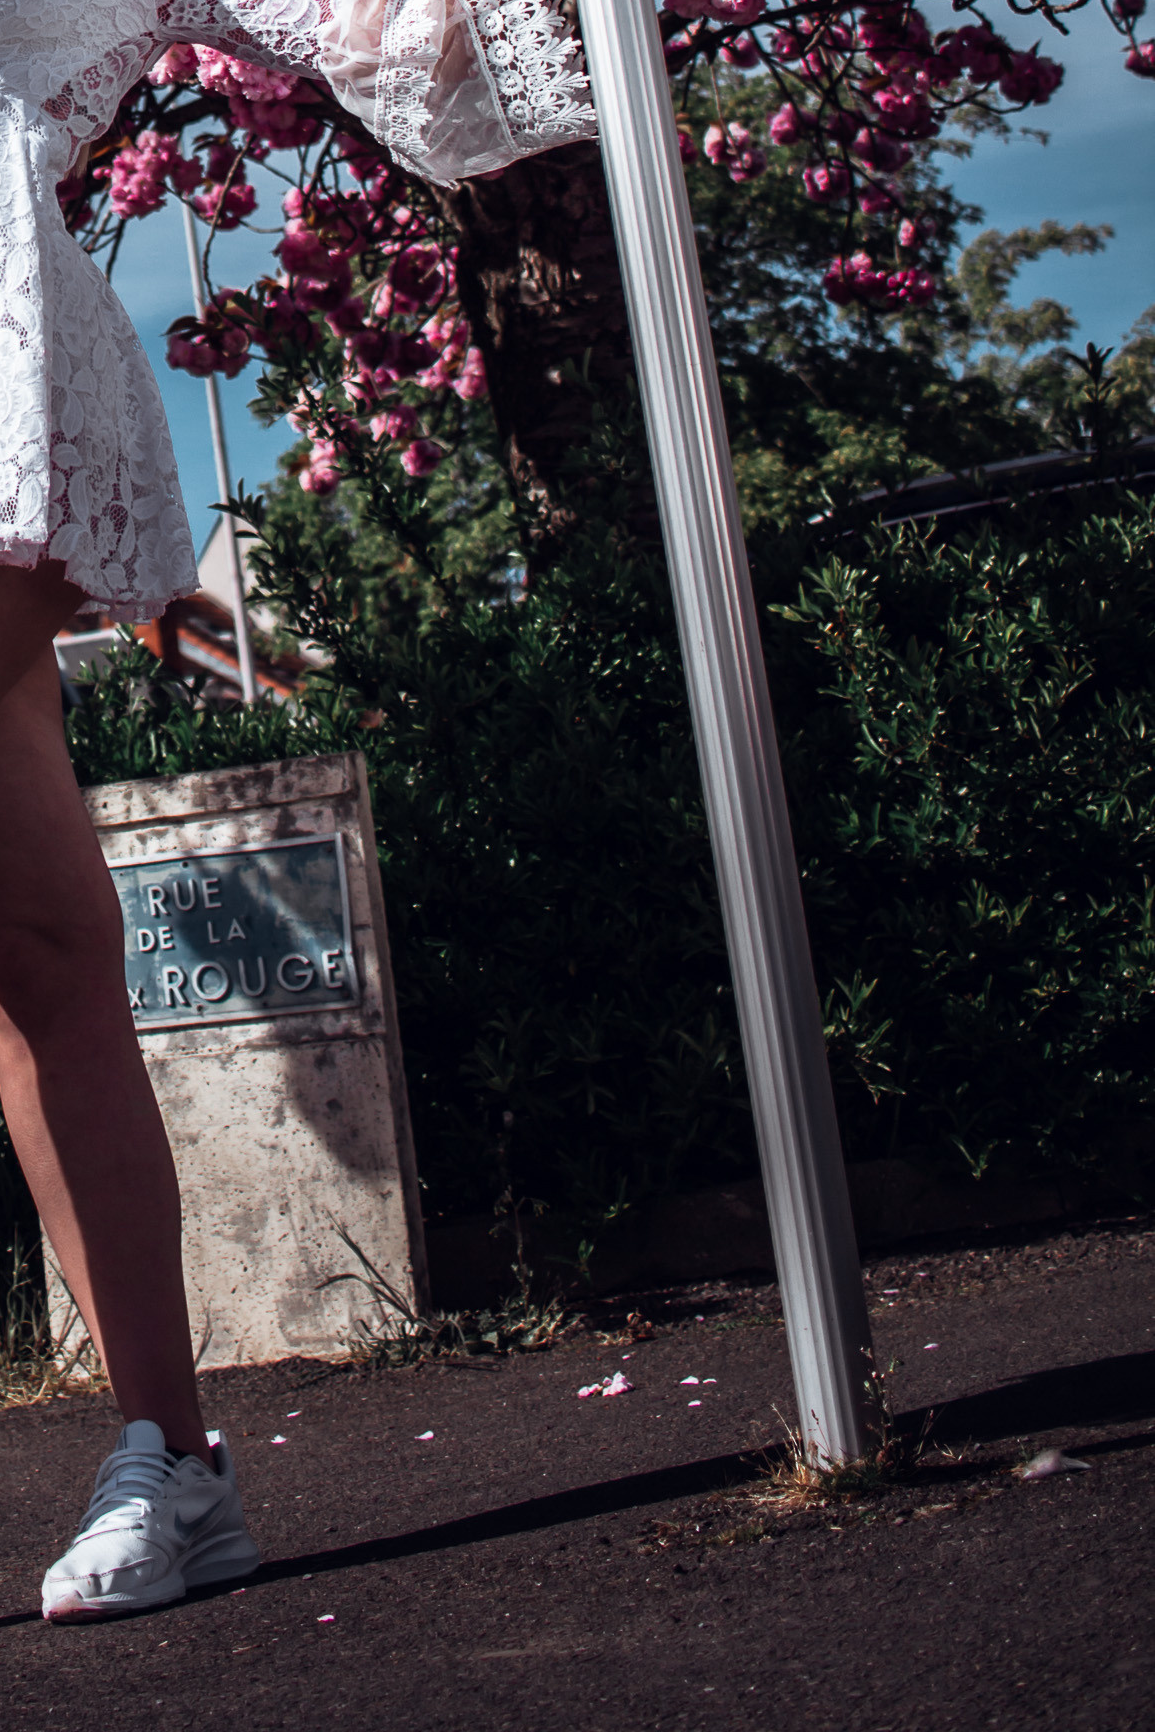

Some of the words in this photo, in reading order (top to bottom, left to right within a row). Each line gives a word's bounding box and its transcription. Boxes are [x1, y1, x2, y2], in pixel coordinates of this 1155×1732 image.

[147, 877, 222, 916] RUE
[137, 926, 174, 952] DE
[207, 918, 245, 944] LA
[161, 948, 343, 1007] ROUGE
